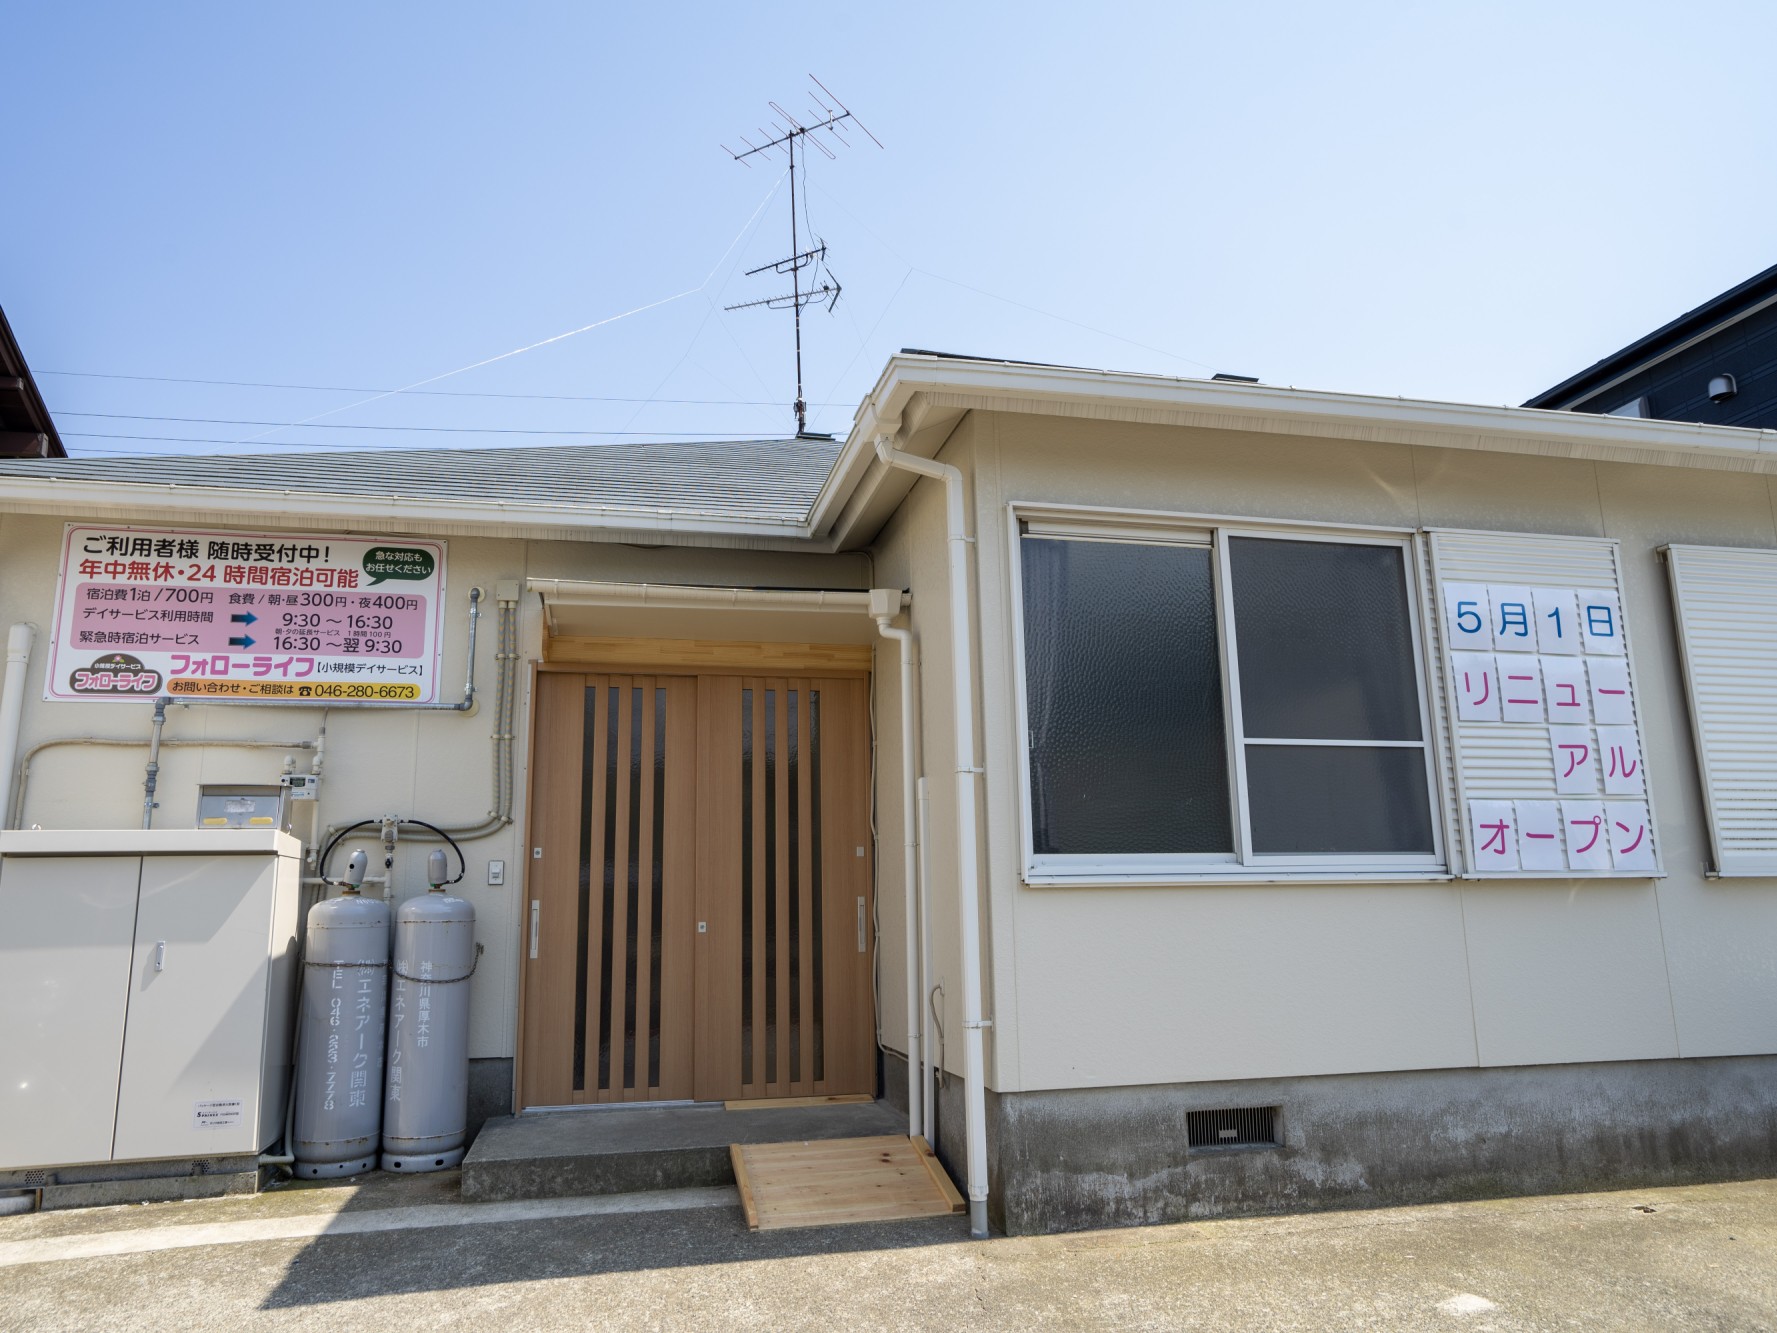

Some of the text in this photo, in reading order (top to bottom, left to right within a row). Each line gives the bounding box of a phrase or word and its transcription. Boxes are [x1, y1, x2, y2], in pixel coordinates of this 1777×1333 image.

[83, 535, 330, 564] ご利用者様 随時受付中!
[375, 550, 423, 562] 急な対応も
[365, 562, 431, 575] お任せください
[82, 607, 214, 623] デイサービス利用時間
[1456, 600, 1614, 638] 5月1日
[79, 631, 199, 645] 緊急時宿泊サービス
[170, 654, 424, 677] フォローライフ 【小規模デイサービス】
[75, 671, 159, 691] フォローライフ
[172, 681, 415, 699] お問い合わせ・ご相談は 046-280-6673
[1463, 671, 1626, 707] リニュー
[1557, 744, 1637, 778] アル
[1479, 815, 1644, 855] オープン
